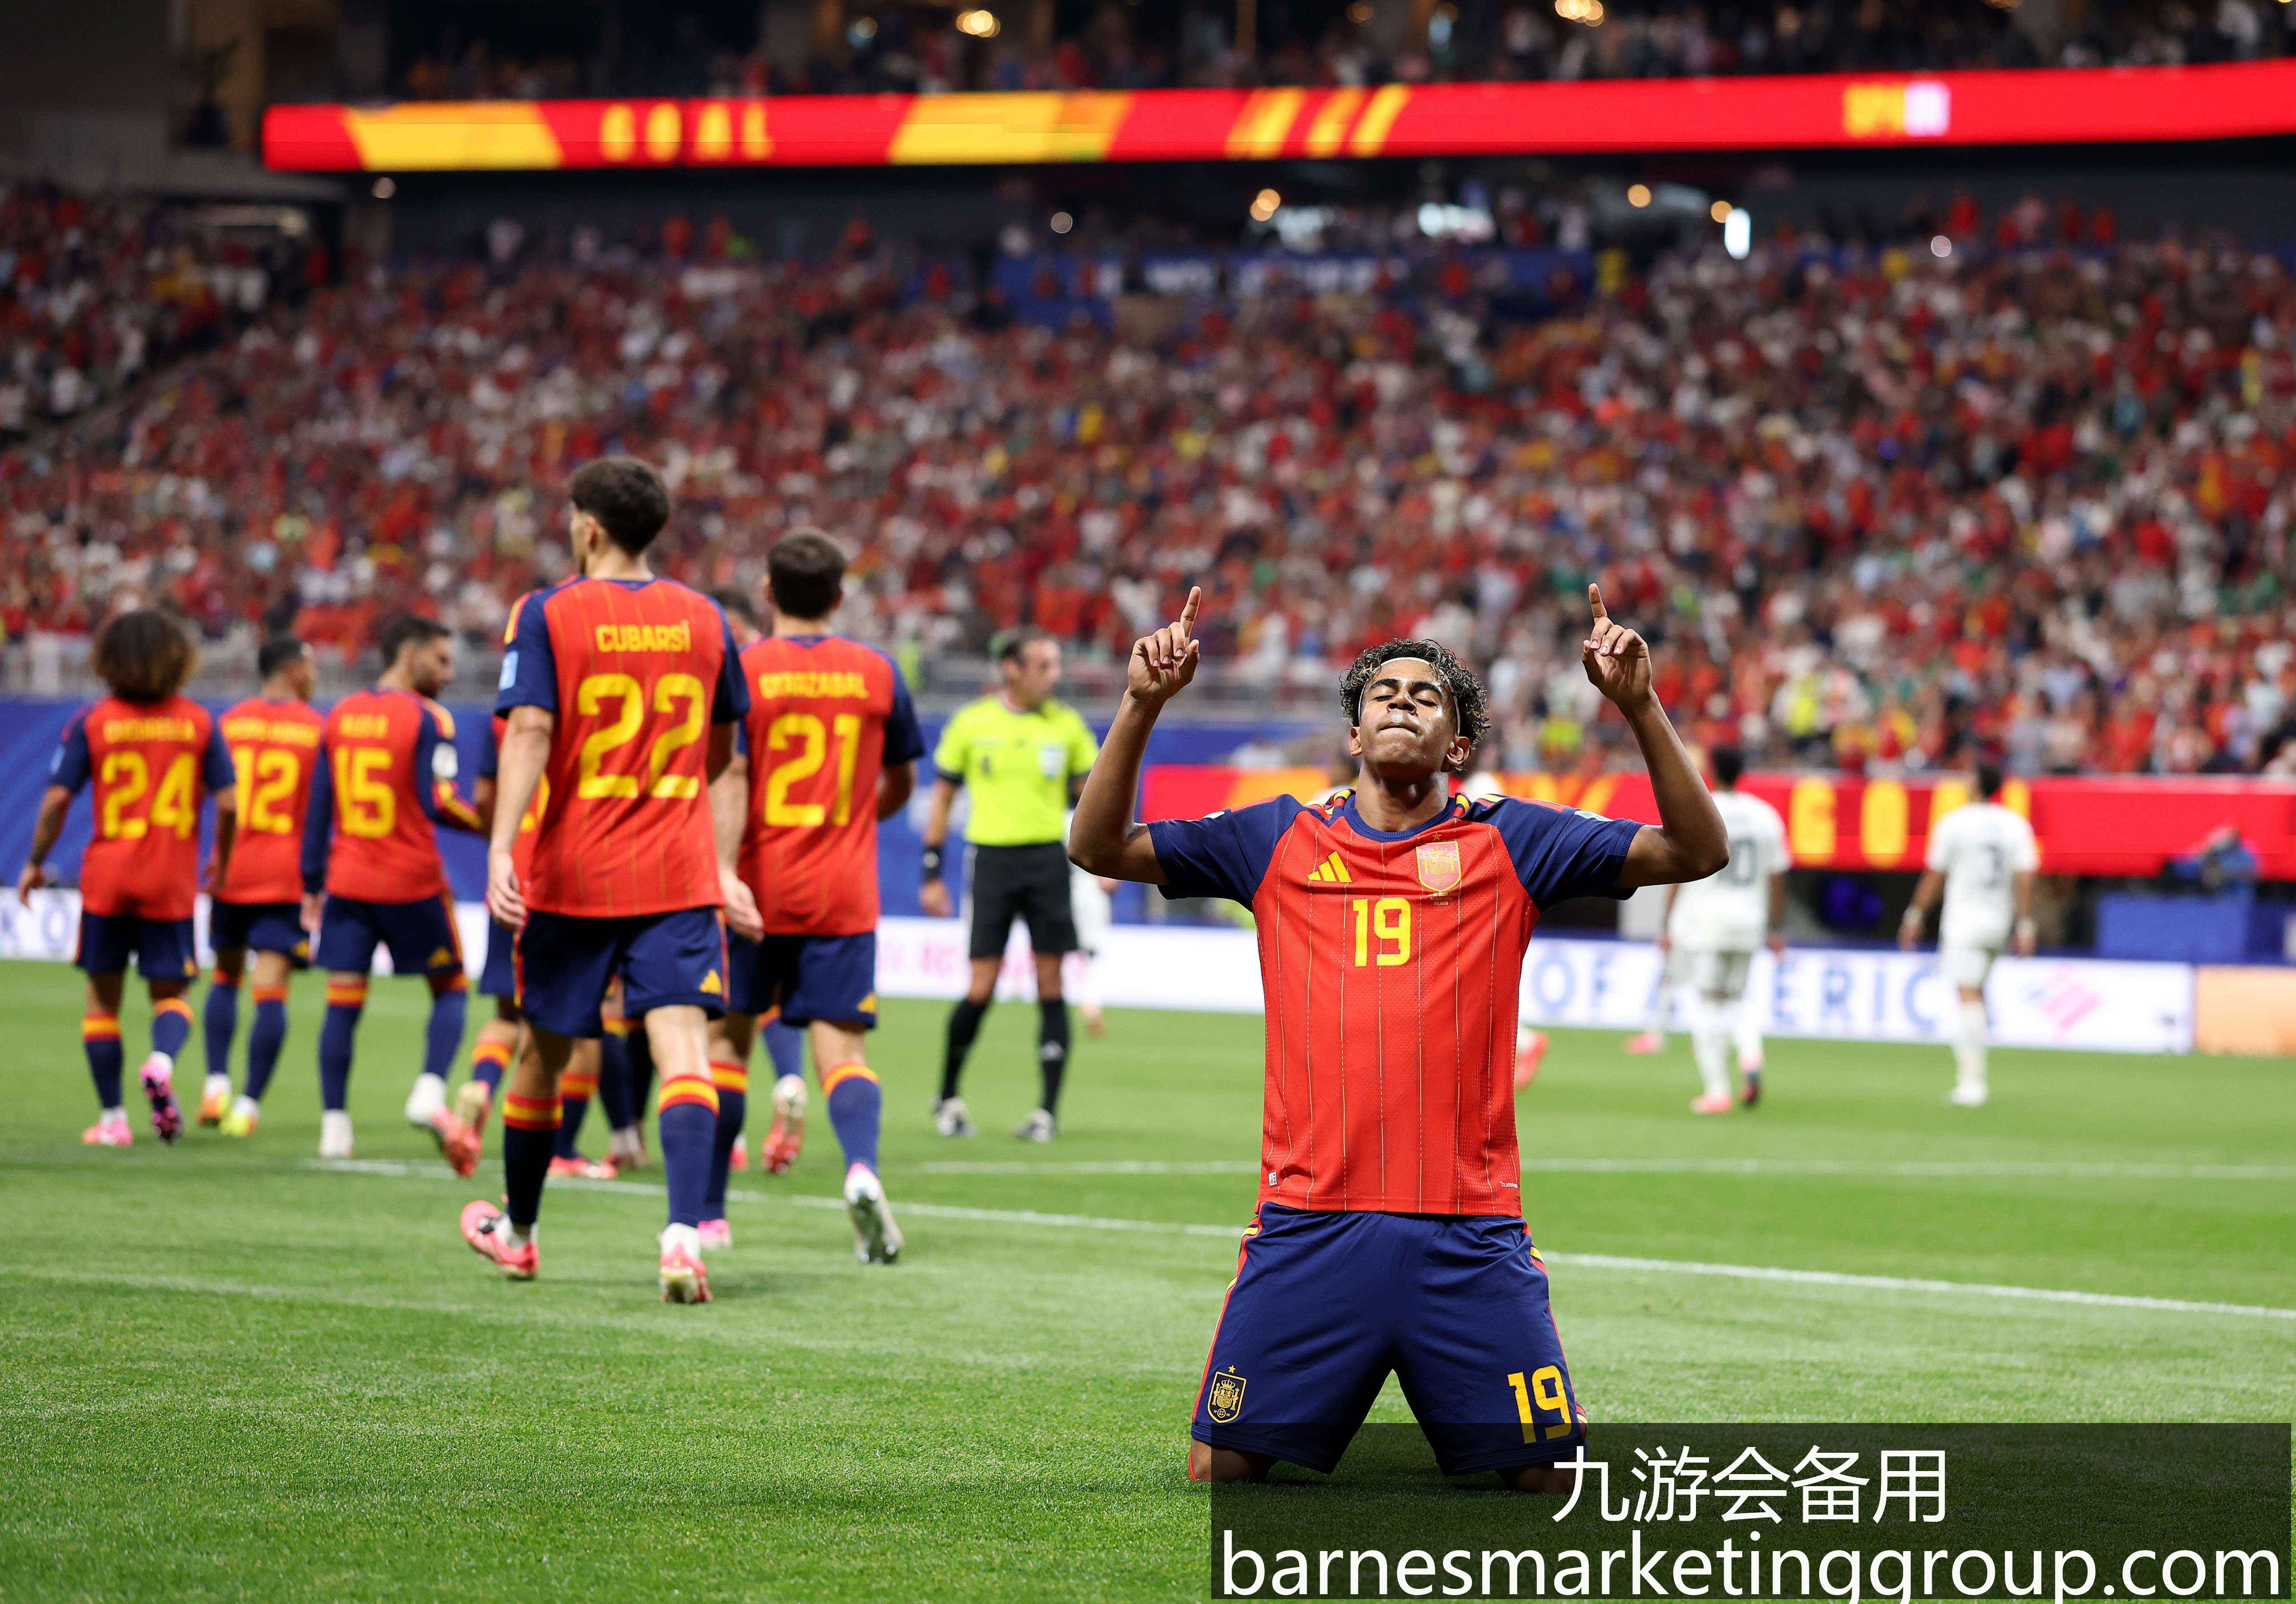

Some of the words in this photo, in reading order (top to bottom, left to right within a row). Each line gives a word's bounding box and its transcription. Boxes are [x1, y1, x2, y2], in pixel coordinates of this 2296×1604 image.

[578, 673, 704, 800] 22
[765, 713, 861, 826] 21
[102, 751, 194, 839] 24
[232, 744, 299, 834] 12
[335, 746, 395, 837] 15
[1353, 897, 1411, 967] 19
[1507, 1365, 1573, 1444] 19
